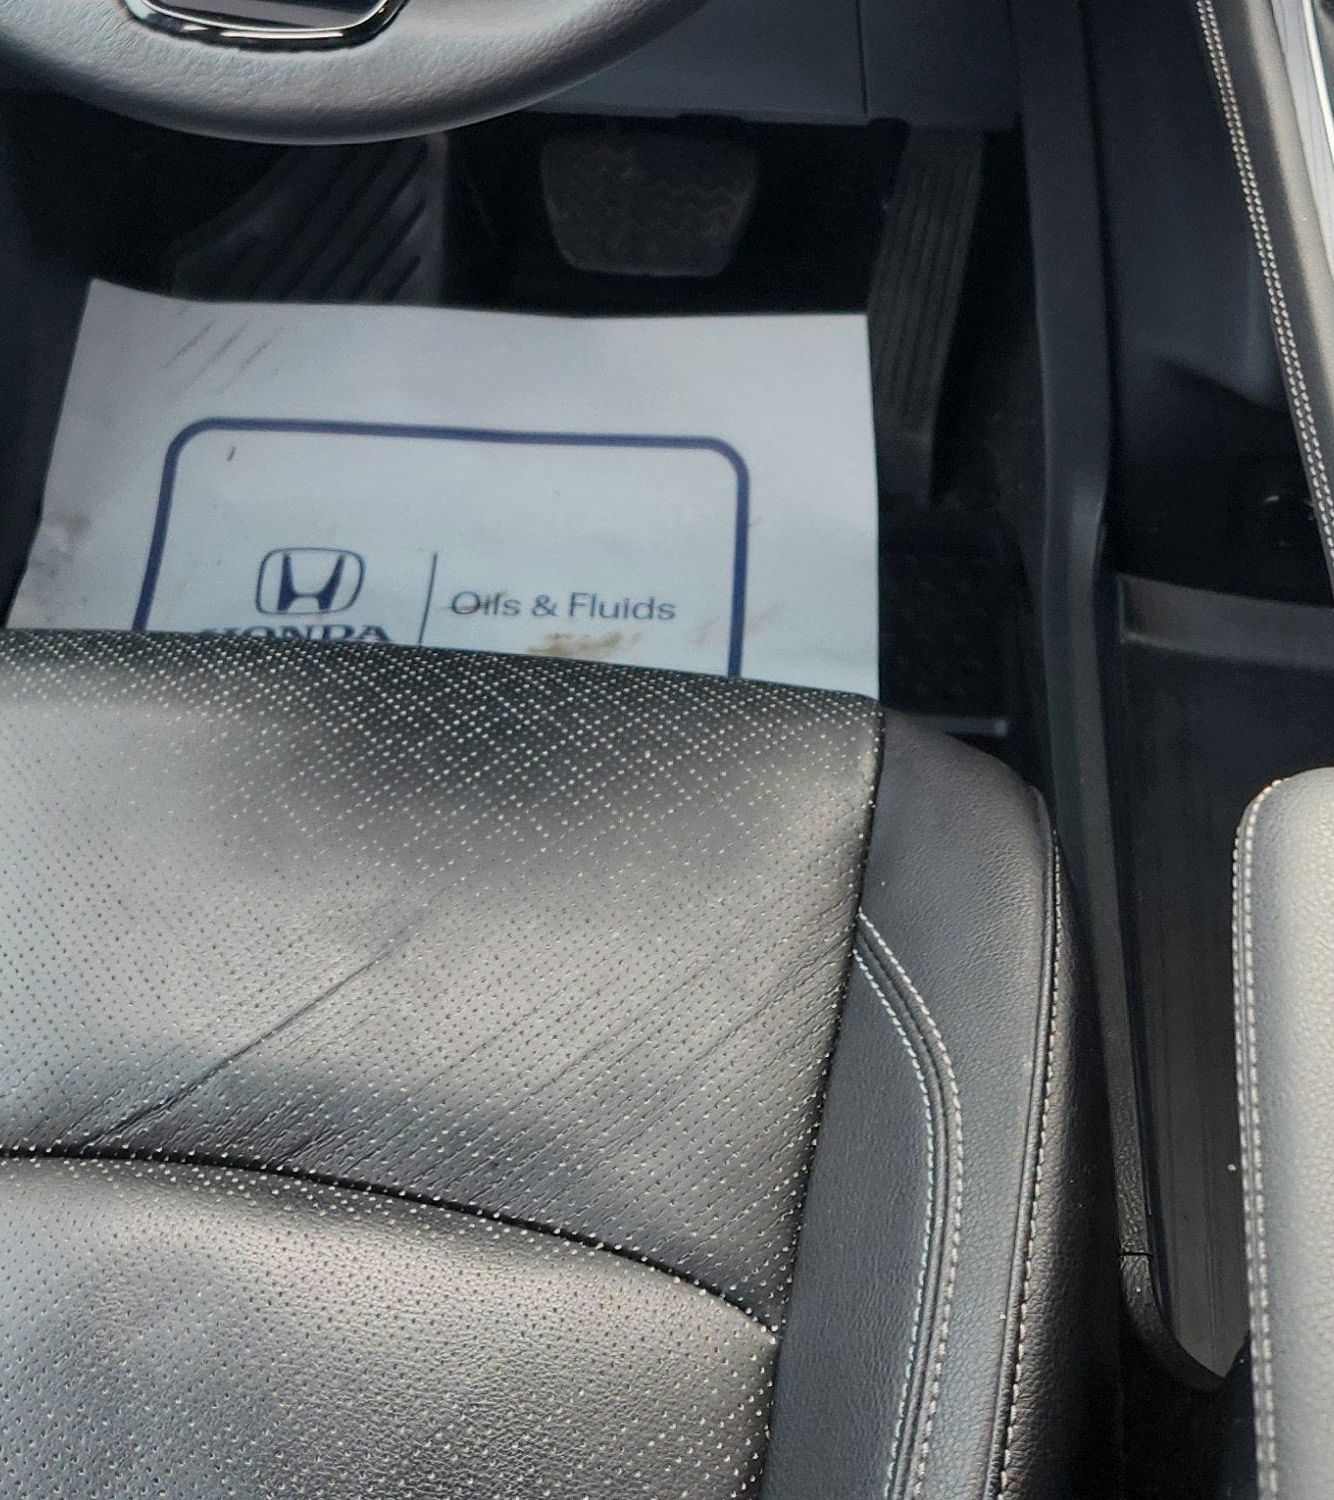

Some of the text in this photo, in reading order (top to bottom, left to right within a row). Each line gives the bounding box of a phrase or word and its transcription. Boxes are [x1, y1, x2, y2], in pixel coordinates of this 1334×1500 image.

[451, 590, 677, 621] Oils & Fluids
